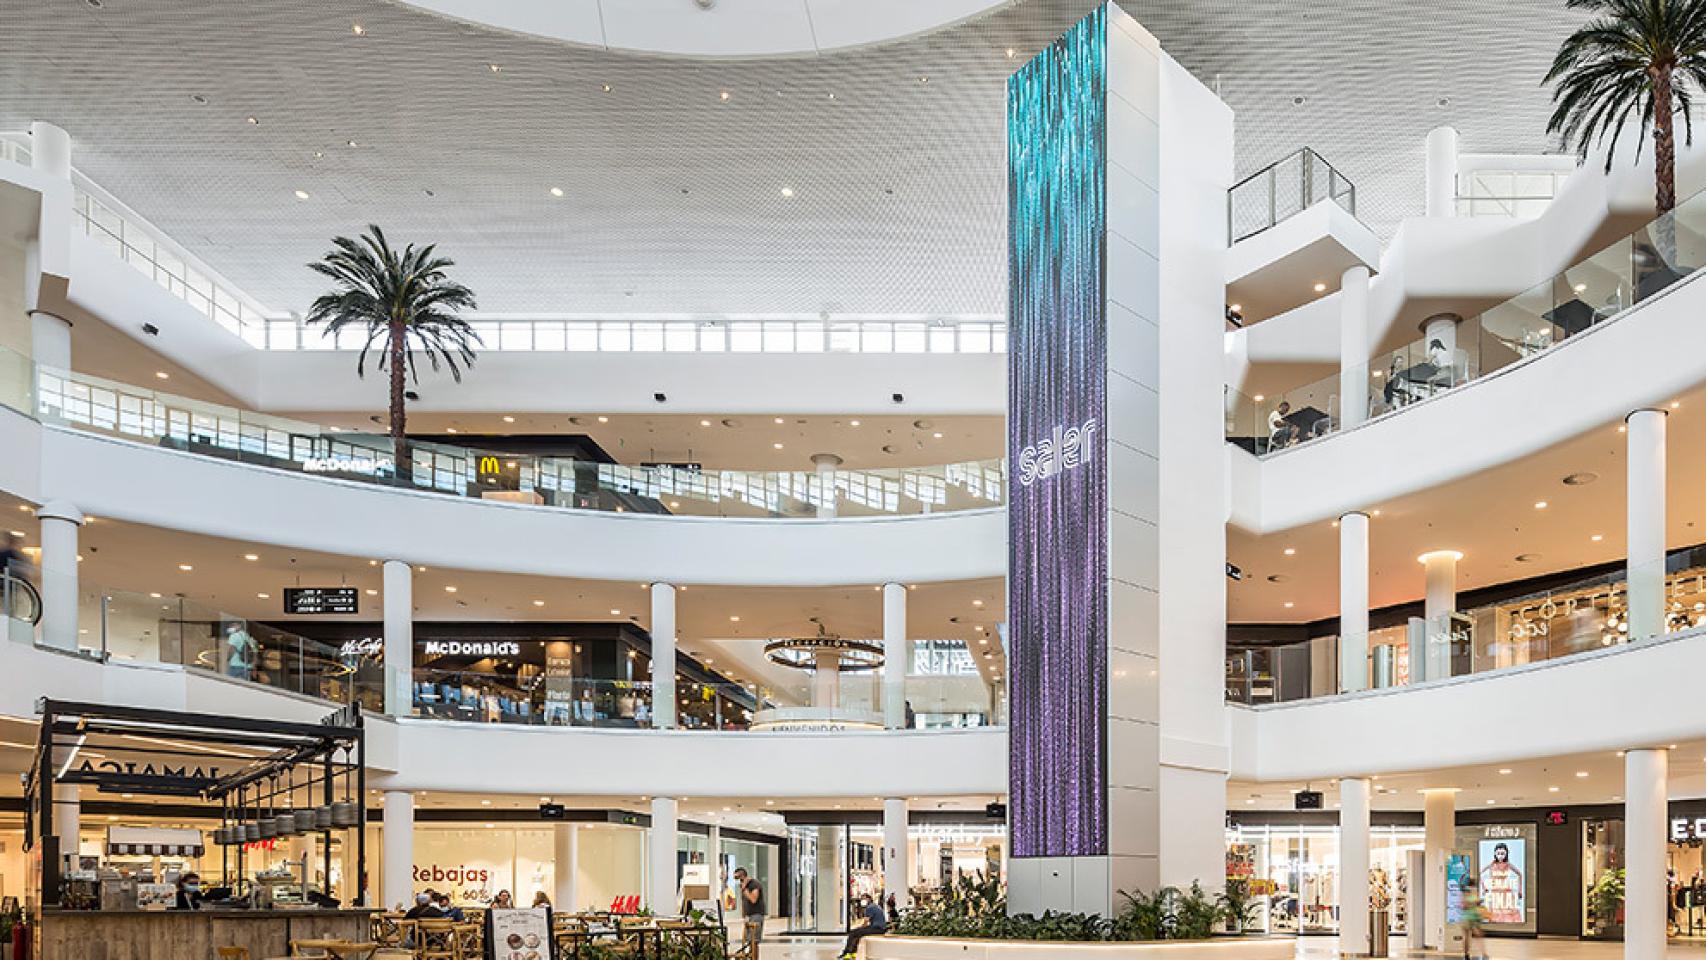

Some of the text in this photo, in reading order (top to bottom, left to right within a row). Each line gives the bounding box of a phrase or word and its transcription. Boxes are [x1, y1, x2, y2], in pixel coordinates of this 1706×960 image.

[1019, 418, 1096, 485] saler
[425, 641, 520, 655] McDonald's
[412, 864, 488, 886] Rebajas
